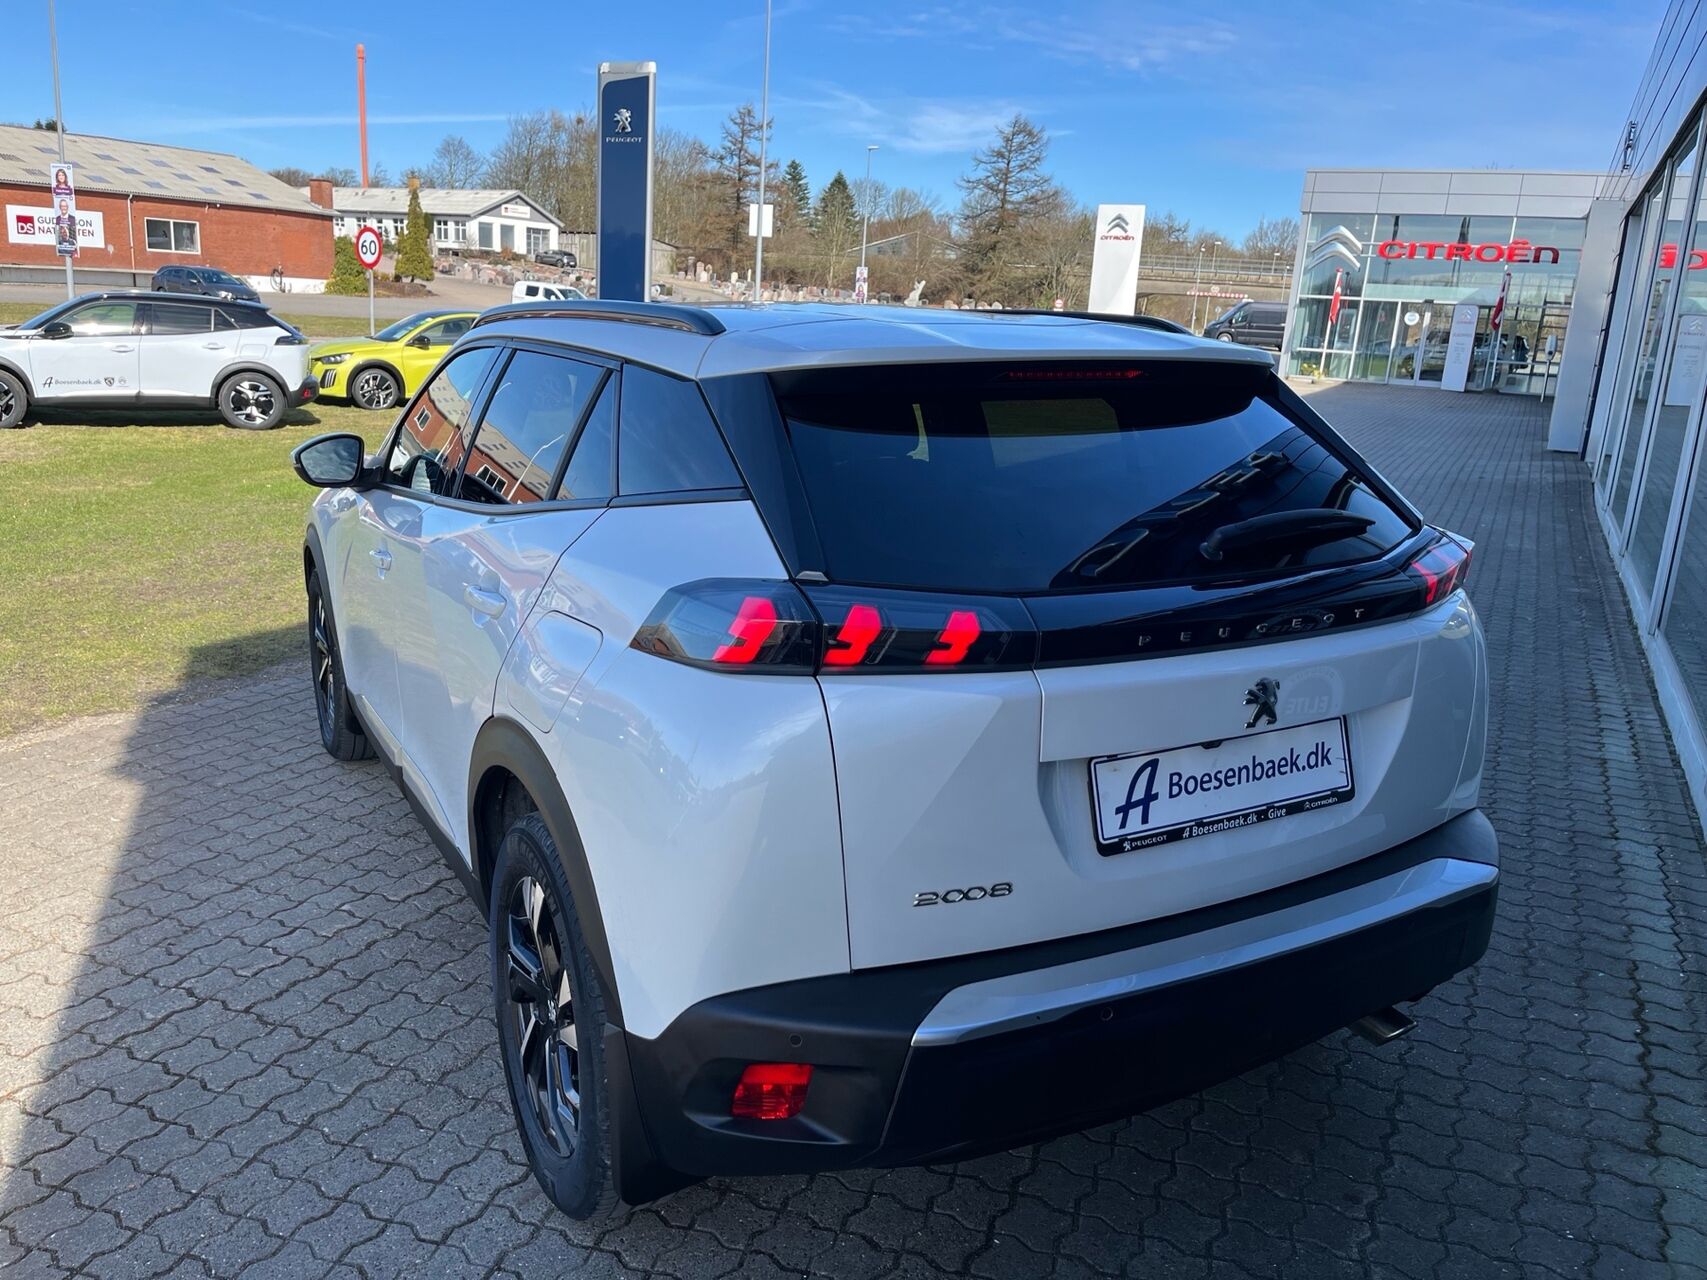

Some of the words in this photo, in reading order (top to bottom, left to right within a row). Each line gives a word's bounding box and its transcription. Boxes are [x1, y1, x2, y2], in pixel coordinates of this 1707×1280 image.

[606, 134, 643, 143] PEUGEOT
[18, 222, 34, 234] DS
[361, 239, 377, 256] 60
[1138, 608, 1365, 647] PEUGEOT
[1115, 757, 1160, 830] A
[1168, 741, 1332, 799] Boesenbaek.dk
[1192, 812, 1258, 837] Boesenbaek.dk
[1268, 807, 1287, 821] Give
[1132, 834, 1168, 848] PEUGEOT
[913, 882, 1014, 907] 2008
